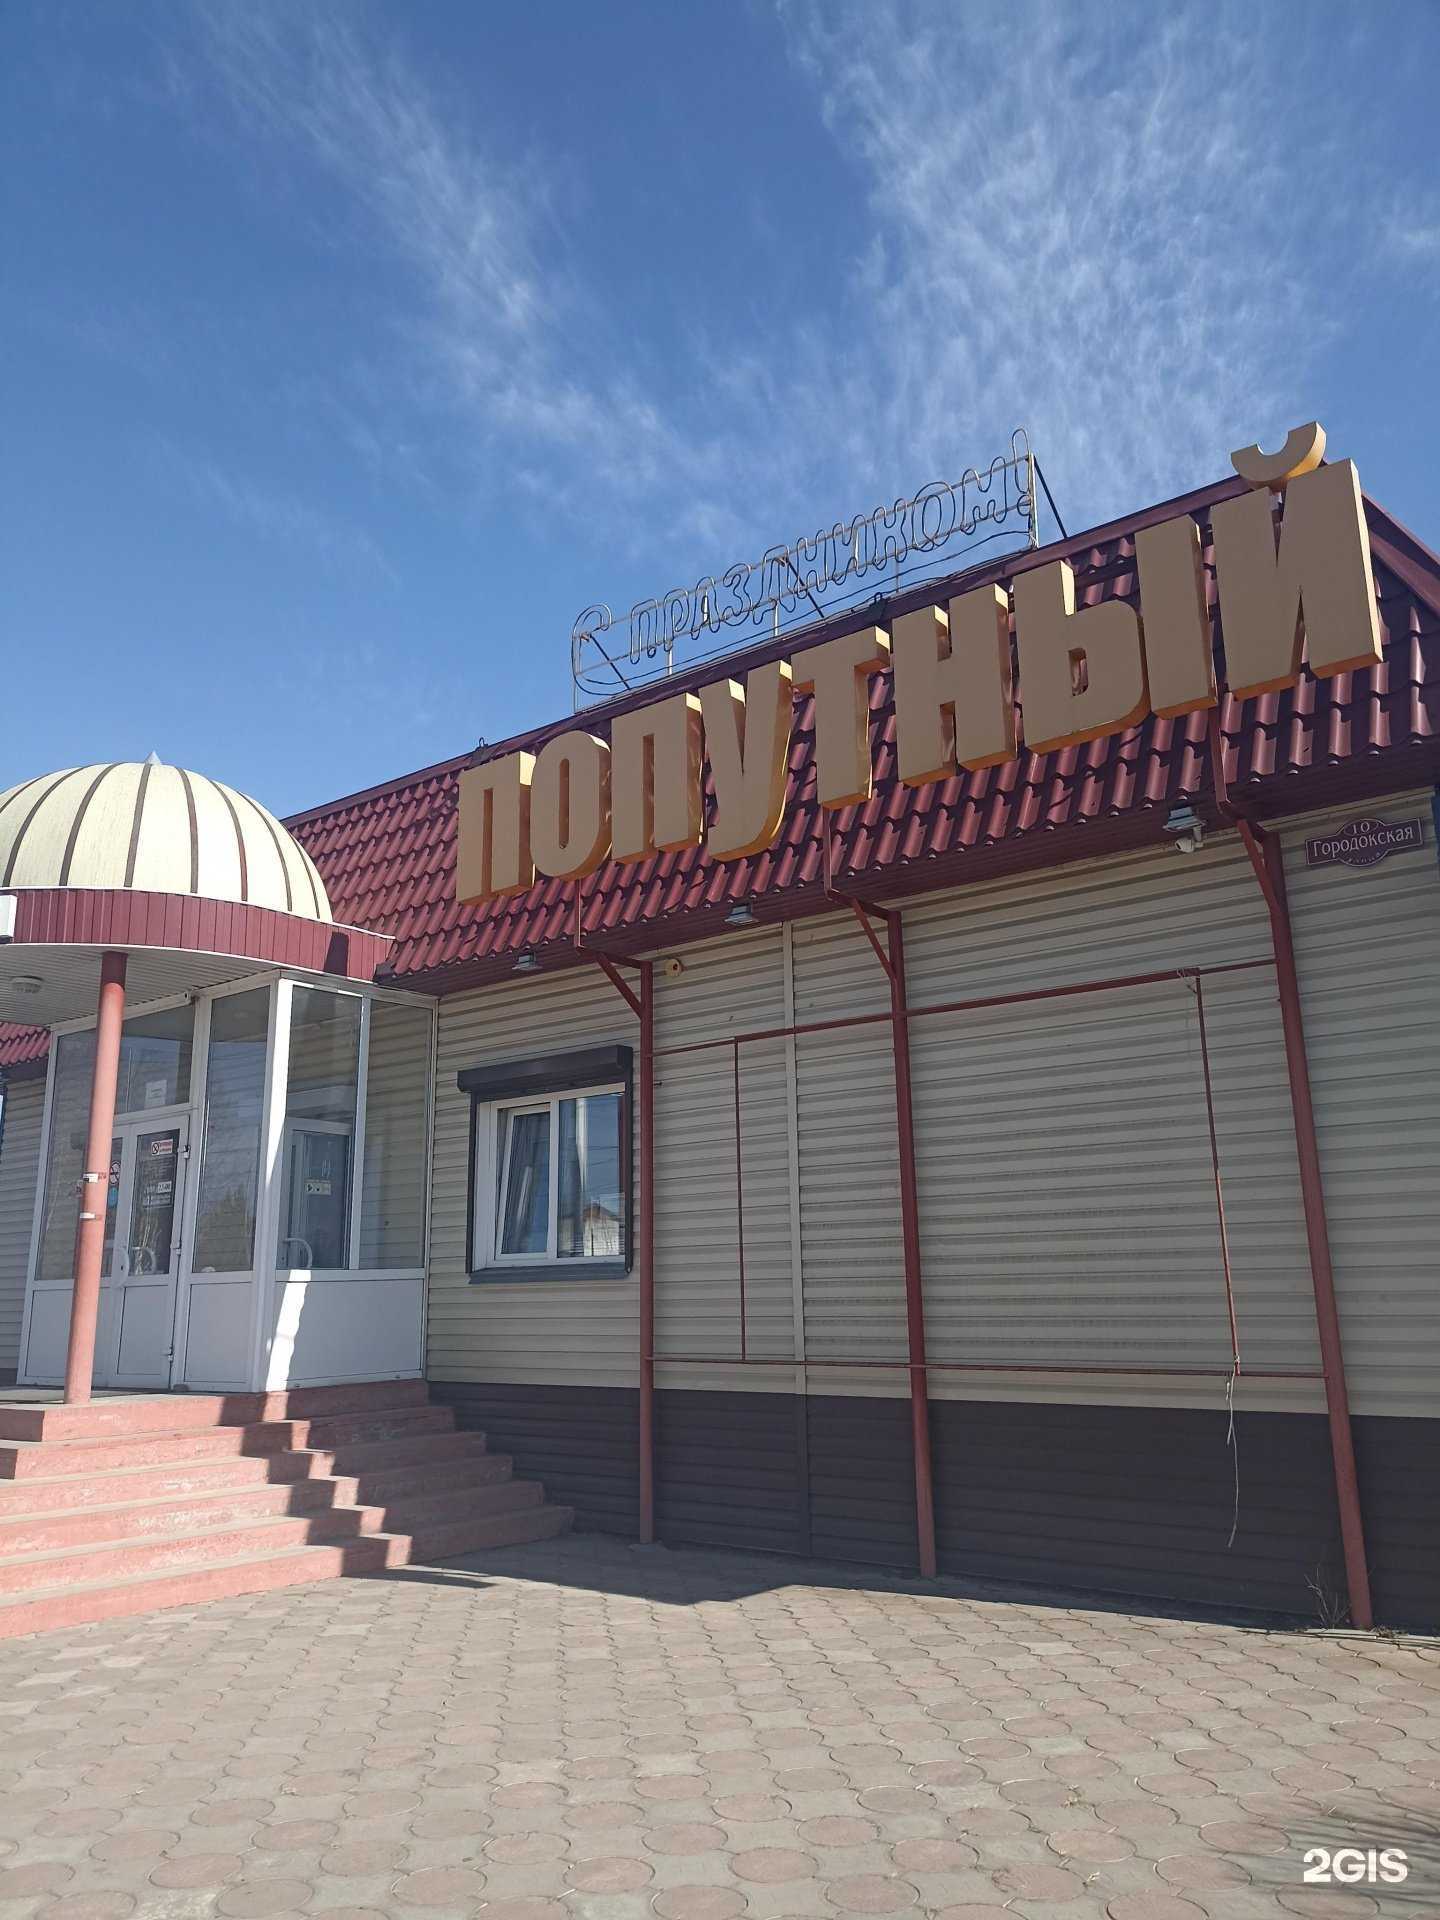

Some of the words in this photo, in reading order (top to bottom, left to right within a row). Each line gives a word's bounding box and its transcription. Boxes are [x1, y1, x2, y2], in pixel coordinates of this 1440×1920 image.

[571, 604, 623, 697] С
[629, 427, 1031, 664] ПРАЗДНИКОМ!
[456, 421, 1383, 905] ПОПУТНЫЙ
[1313, 826, 1414, 858] Городокская
[1352, 821, 1370, 834] 10
